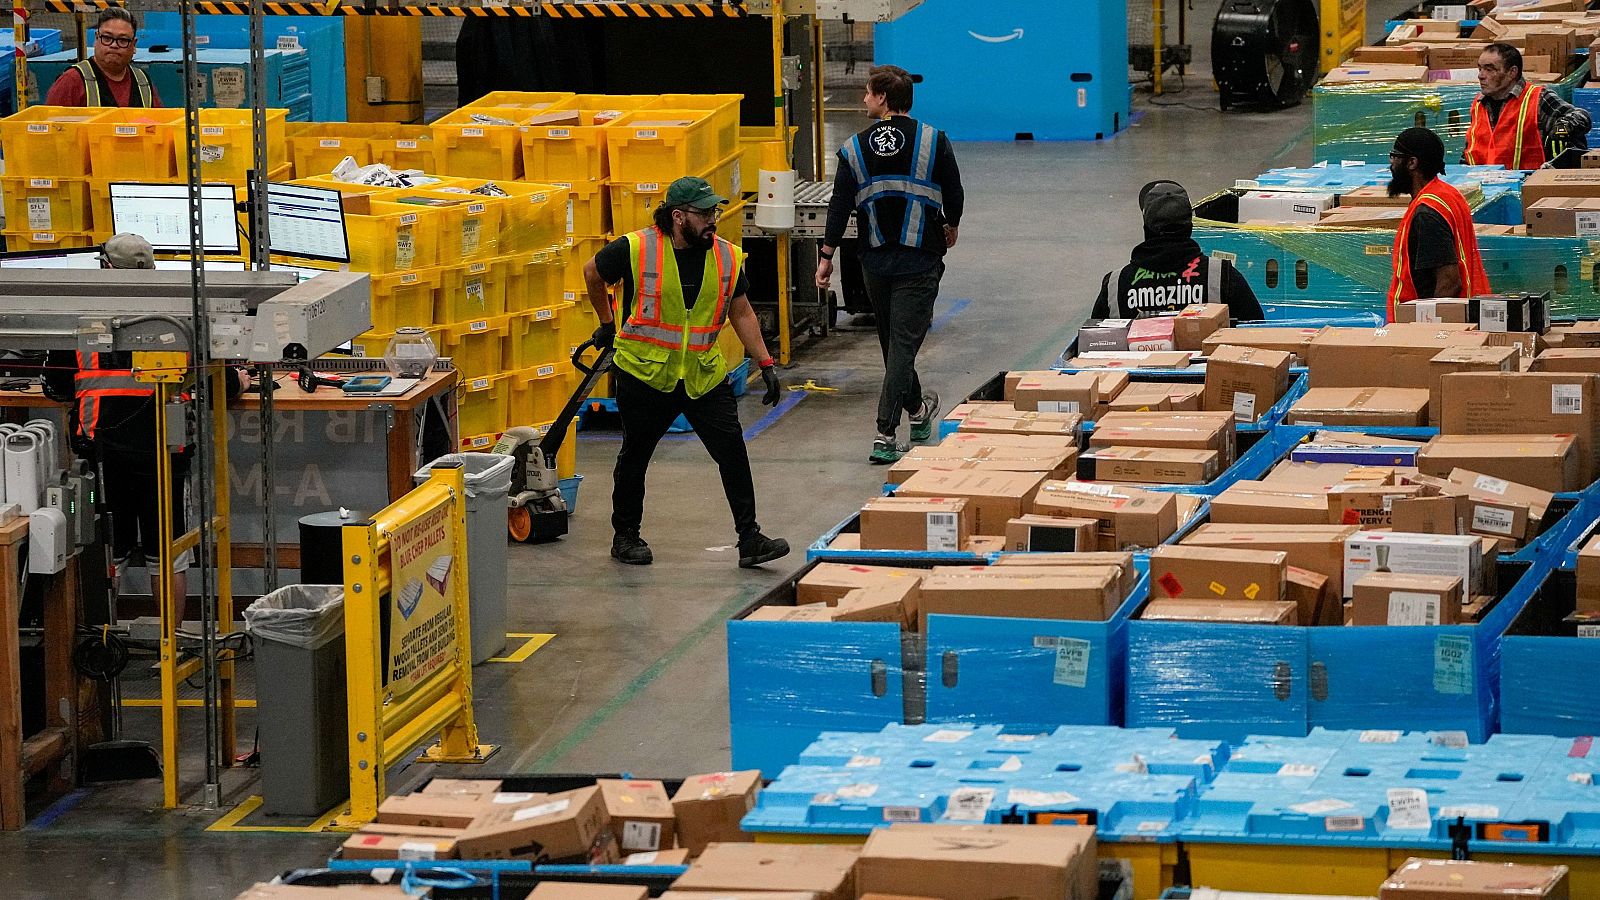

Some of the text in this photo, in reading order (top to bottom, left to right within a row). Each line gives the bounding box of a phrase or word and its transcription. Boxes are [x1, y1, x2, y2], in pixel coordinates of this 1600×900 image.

[1127, 278, 1204, 309] amazing
[402, 527, 414, 546] NOT
[1360, 517, 1383, 525] VERY
[400, 525, 446, 569] BLUE CHEP PALLETS
[394, 647, 411, 667] WOOD
[410, 635, 428, 656] PALLETS
[428, 628, 438, 644] AND
[437, 621, 448, 638] SEND
[401, 604, 452, 649] SEPARATE FROM REGULAR
[392, 628, 456, 682] REMOVAL FROM THE BUILDING
